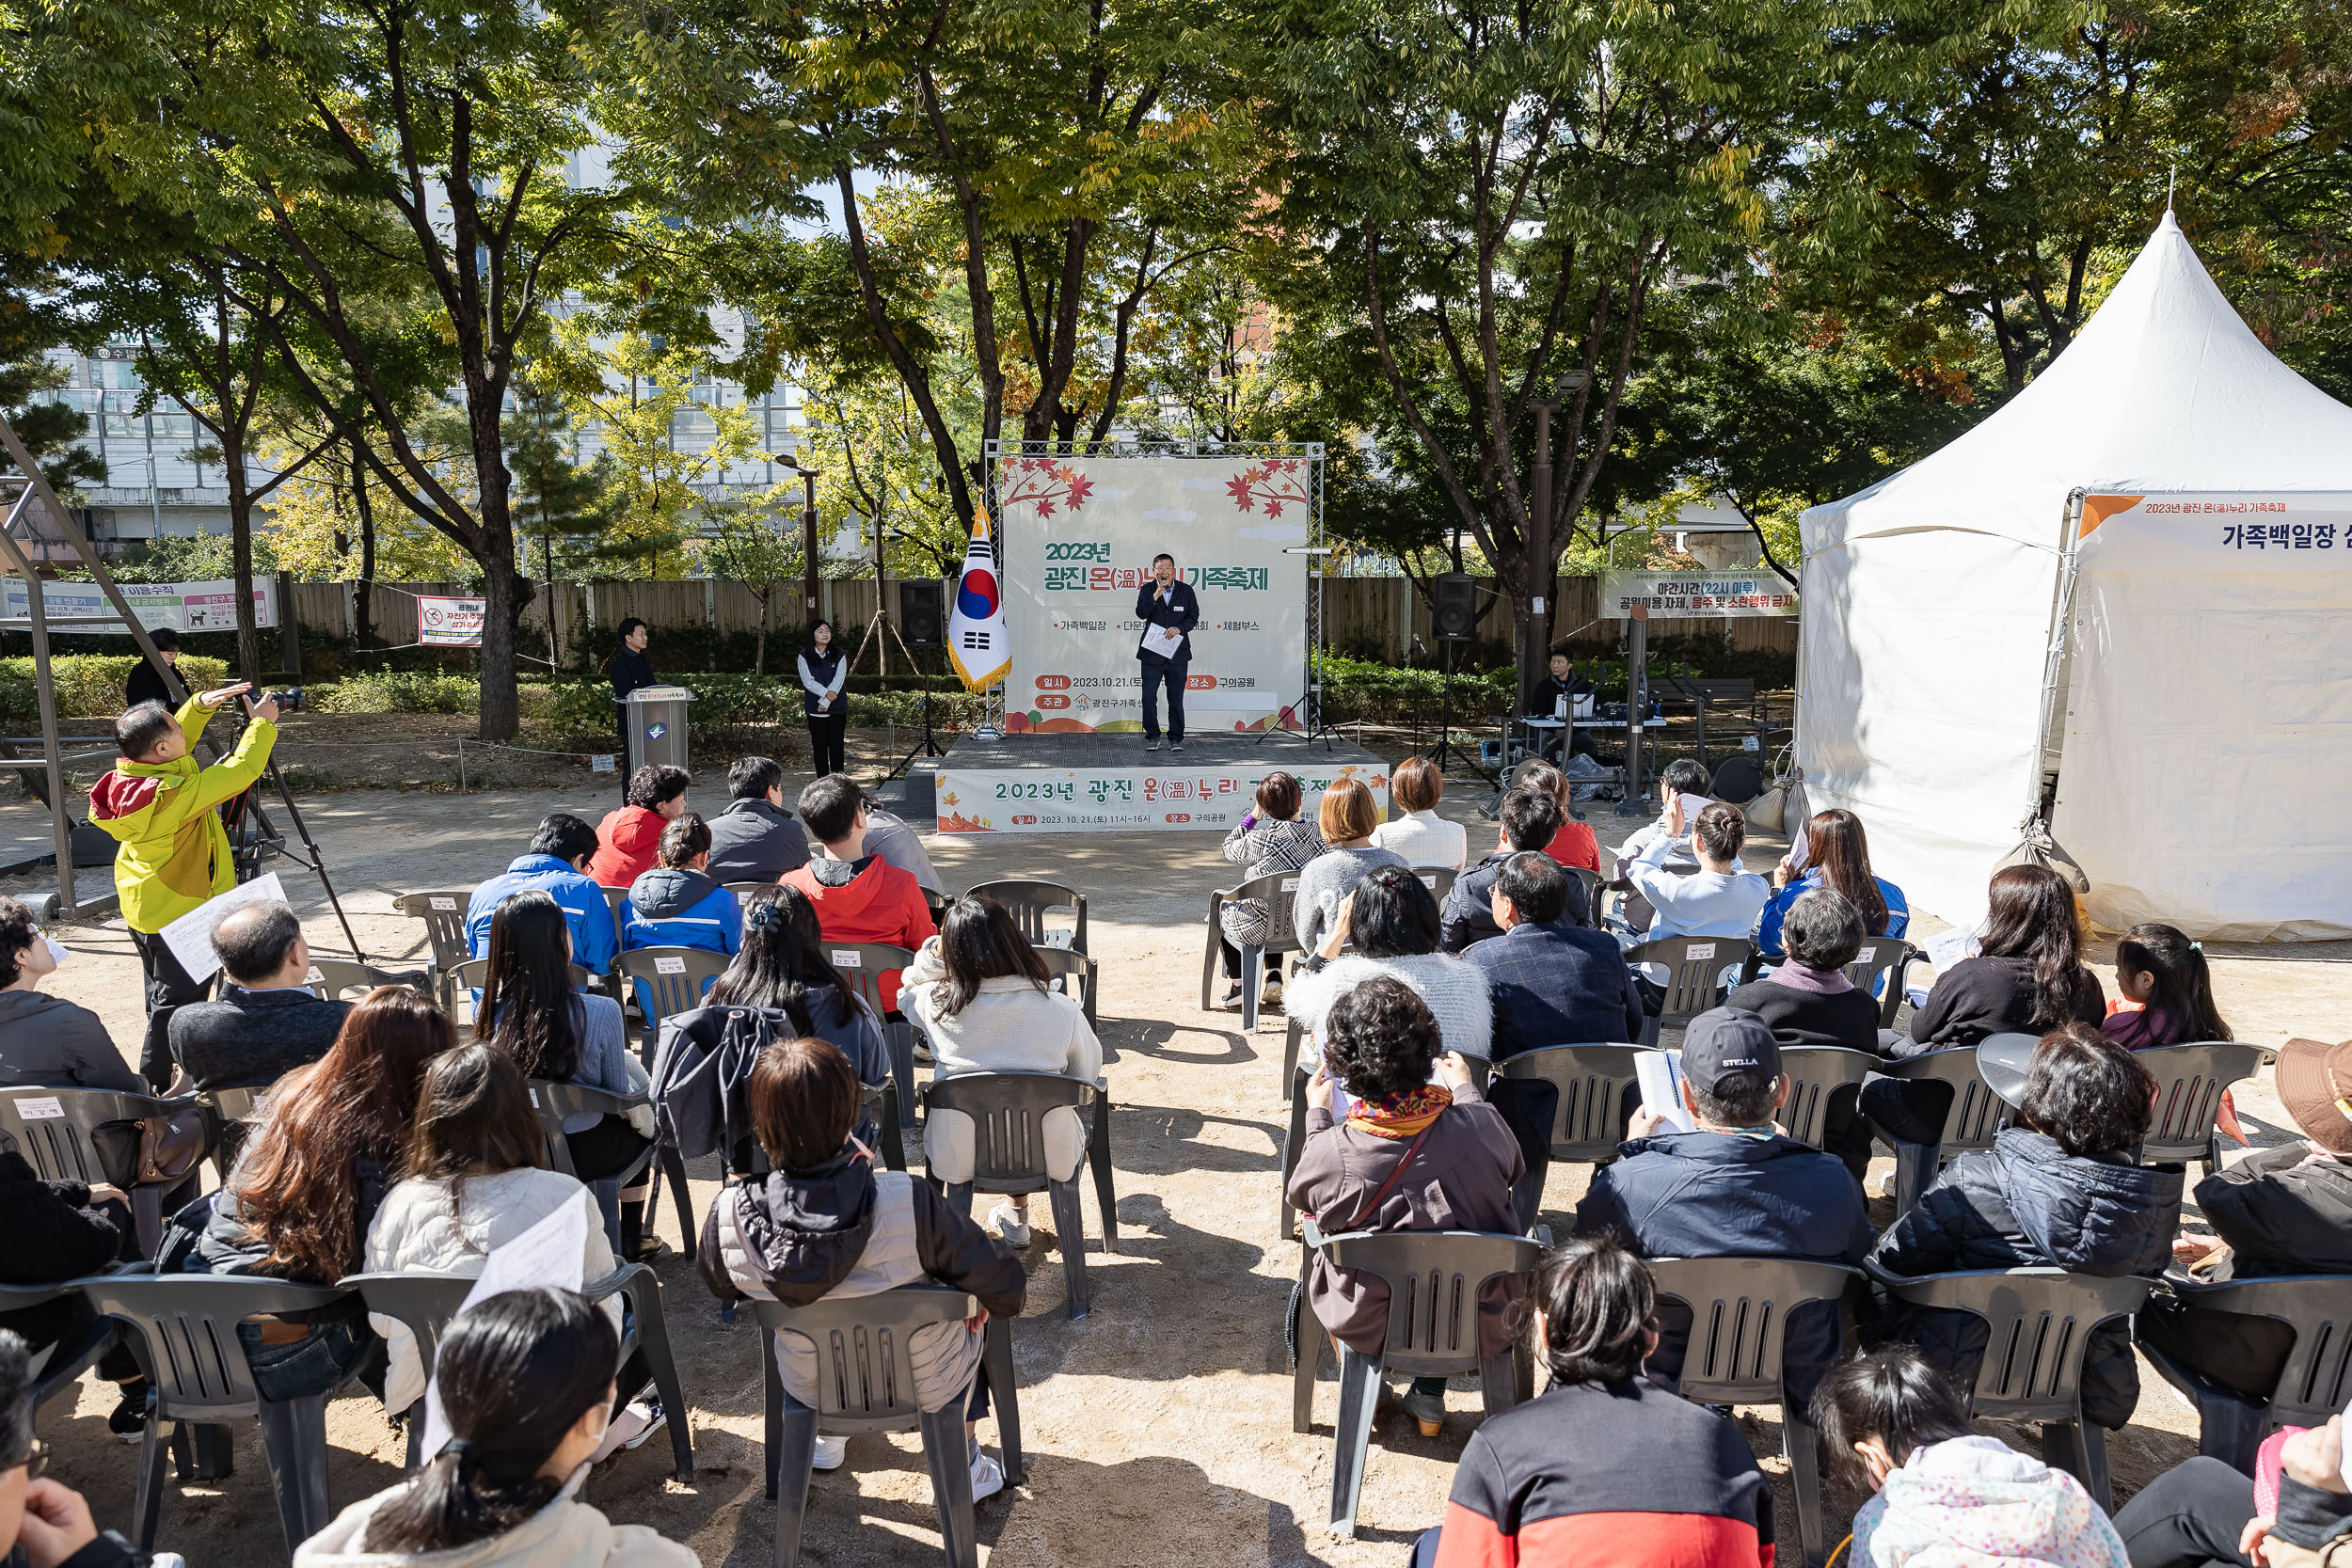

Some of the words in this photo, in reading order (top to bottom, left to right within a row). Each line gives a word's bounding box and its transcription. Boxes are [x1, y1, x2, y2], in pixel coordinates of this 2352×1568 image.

[2146, 503, 2181, 514] 2023년
[2183, 503, 2201, 514] 광진
[2204, 503, 2248, 514] 온(溫)누리
[2249, 502, 2286, 513] 가족축제
[2222, 524, 2337, 549] 가족백일장
[1044, 542, 1110, 562] 2023년
[1044, 566, 1087, 590] 광진
[1187, 566, 1269, 591] 가족축제
[128, 585, 174, 595] 이용수칙
[1658, 581, 1728, 595] 야간시간(22시
[1732, 580, 1757, 594] 이후)
[1664, 596, 1689, 610] 자제,
[1692, 595, 1712, 609] 음주
[1715, 596, 1725, 608] 및
[1728, 594, 1770, 608] 소란행위
[1772, 594, 1793, 608] 금지
[1060, 621, 1106, 631] 가족백일장
[1222, 621, 1260, 631] 체험부스
[1043, 677, 1064, 688] 일시
[1189, 677, 1210, 689] 장소
[1218, 677, 1255, 688] 구의공원
[1043, 697, 1064, 706] 주관
[994, 782, 1075, 801] 2023년
[1088, 778, 1134, 803] 광진
[1143, 777, 1238, 803] 온(溫)누리
[1015, 815, 1037, 824] 일시
[1041, 815, 1063, 825] 2023.
[1066, 815, 1079, 825] 10.
[1081, 814, 1107, 825] 21.(토)
[1109, 814, 1151, 825] 11시~16시
[1169, 814, 1191, 823] 장소
[1195, 813, 1226, 824] 구의공원
[1722, 1057, 1758, 1068] STELLA
